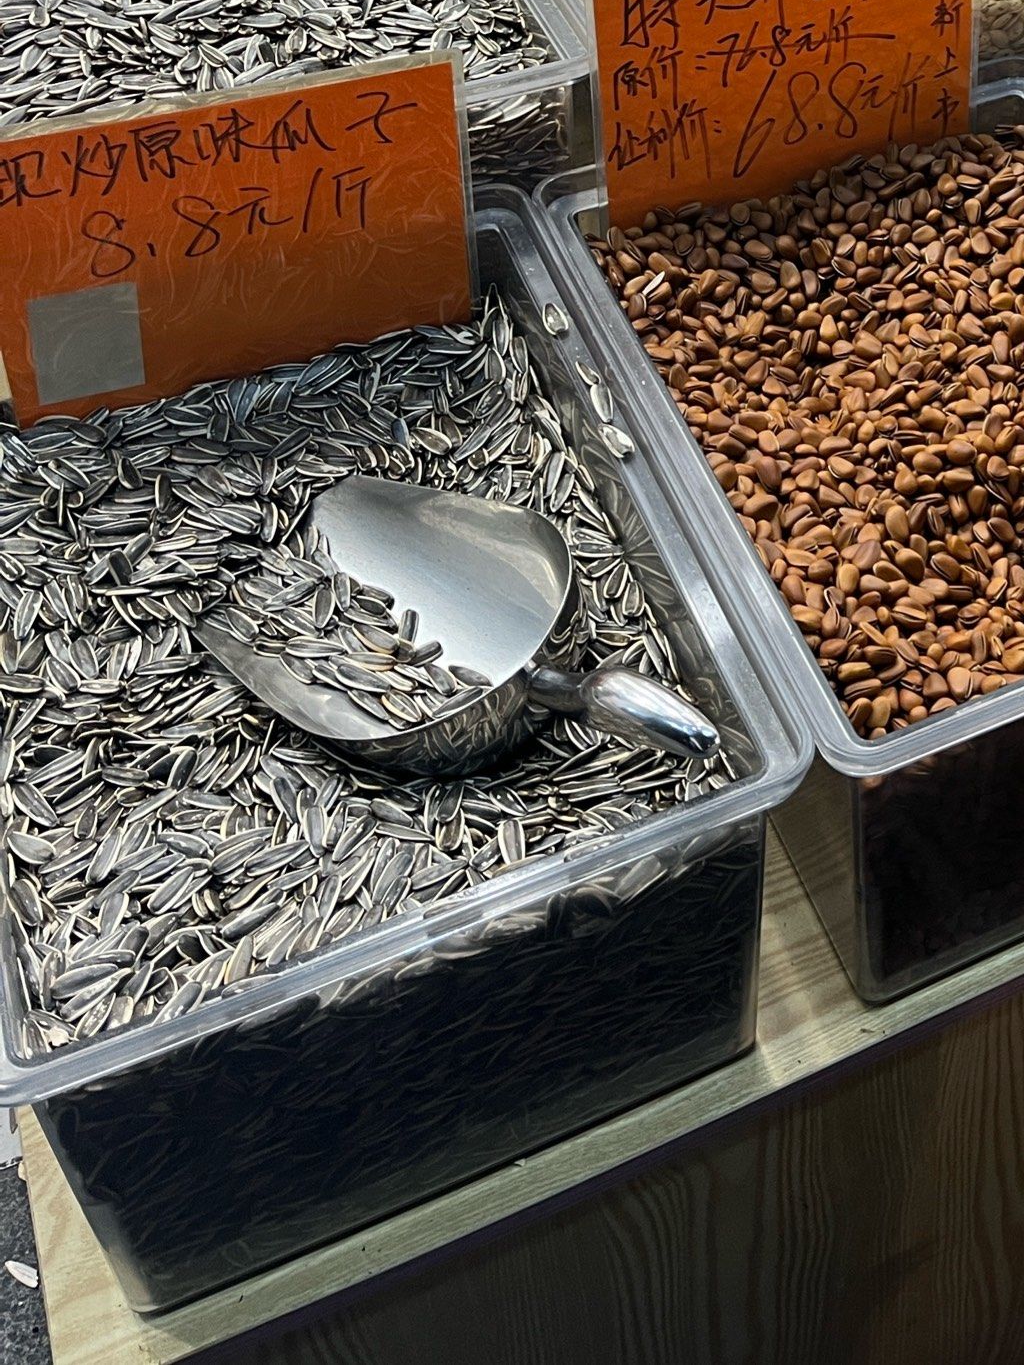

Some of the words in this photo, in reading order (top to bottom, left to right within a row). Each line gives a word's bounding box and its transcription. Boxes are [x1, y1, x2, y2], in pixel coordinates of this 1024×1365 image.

[0, 91, 418, 207] 现炒原味瓜子
[82, 167, 371, 278] 8.8元/斤
